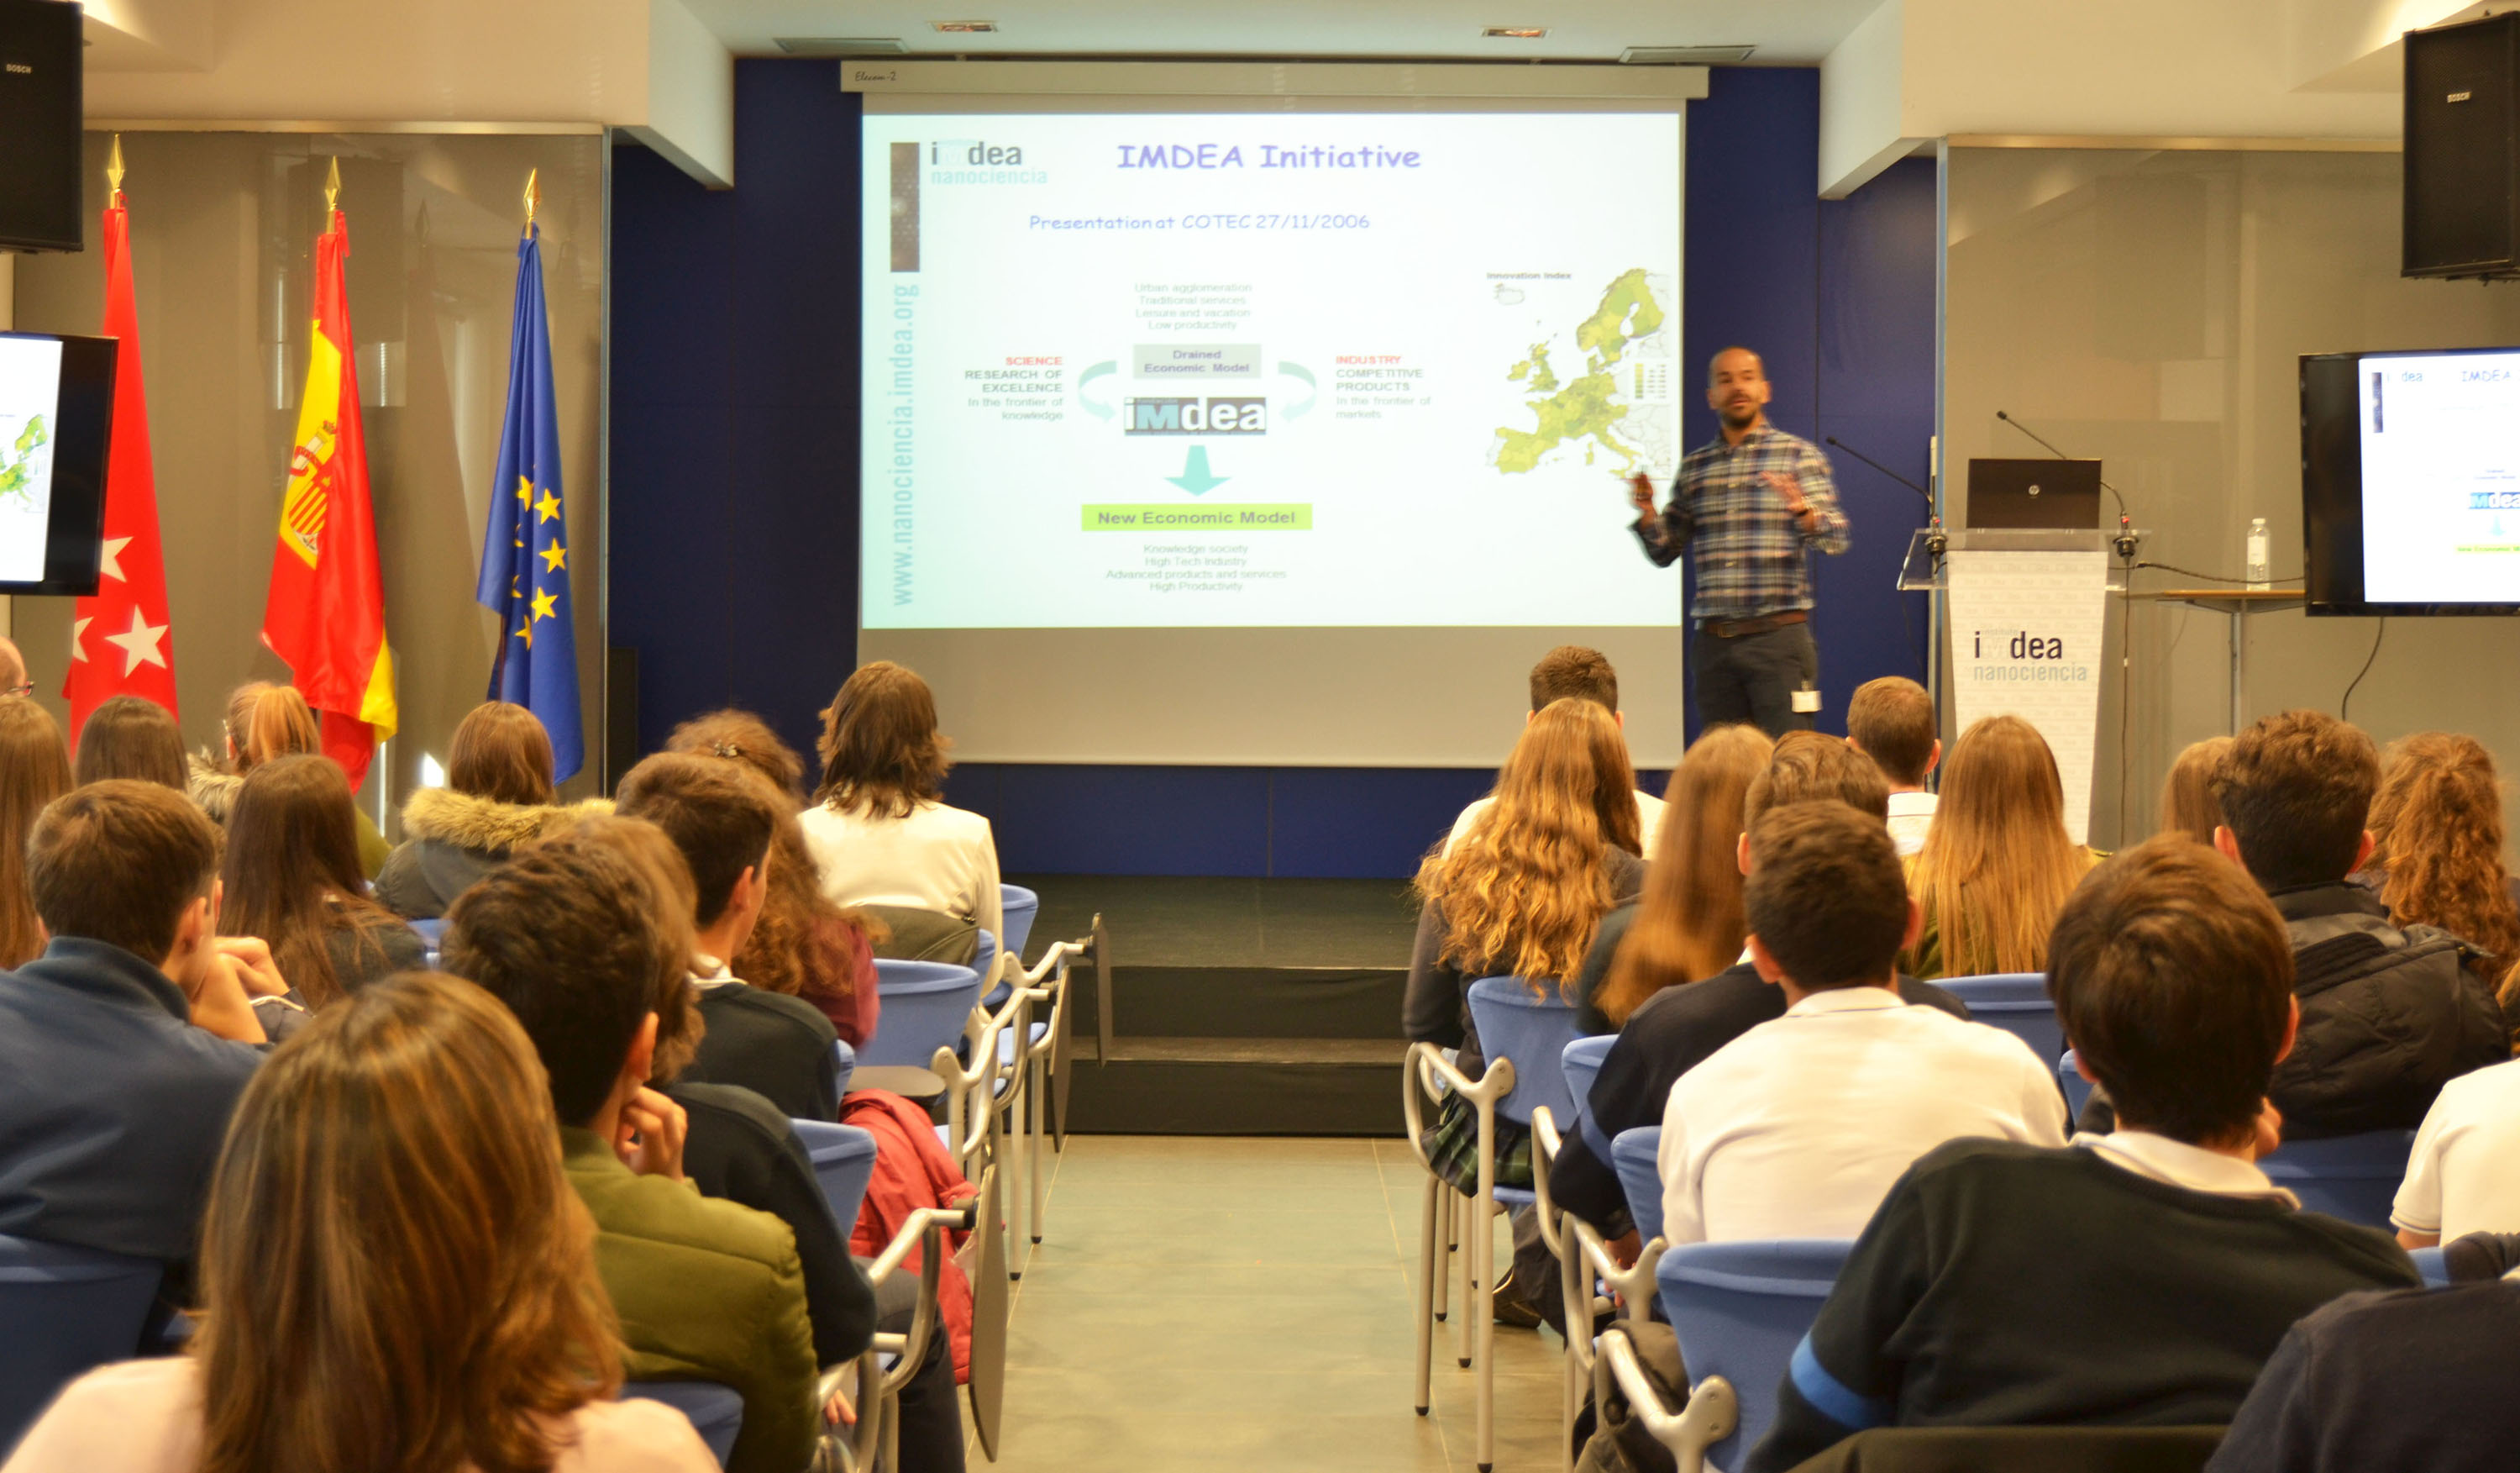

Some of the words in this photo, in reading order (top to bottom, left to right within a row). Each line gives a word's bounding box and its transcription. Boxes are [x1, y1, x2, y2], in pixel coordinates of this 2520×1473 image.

[7, 64, 31, 74] BOSCH
[1116, 143, 1243, 169] IMDEA
[1260, 145, 1420, 169] Initiative
[932, 168, 1047, 184] nanociencia
[1029, 215, 1152, 229] Presentation
[1155, 216, 1175, 229] at
[1181, 214, 1250, 229] COTEC
[1255, 214, 1370, 229] 27/11/2006
[1135, 283, 1168, 292] Urban
[1172, 283, 1252, 294] agglomeration
[1140, 296, 1197, 304] Traditional
[1200, 296, 1246, 304] services
[1136, 308, 1176, 317] Leisure
[1179, 308, 1200, 317] and
[1203, 308, 1251, 317] vacation
[1148, 320, 1170, 329] Low
[1174, 320, 1236, 331] productivity
[1173, 350, 1222, 360] Drained
[1336, 355, 1401, 365] INDUSTRY
[1005, 356, 1063, 366] SCIENCE
[1144, 364, 1205, 372] Economic
[1213, 363, 1250, 372] Model
[1336, 368, 1424, 377] COMPETITIVE
[965, 370, 1037, 379] RESEARCH
[1045, 370, 1063, 379] OF
[982, 383, 1063, 392] EXCELENCE
[1336, 381, 1410, 391] PRODUCTS
[968, 397, 979, 407] In
[983, 397, 1000, 407] the
[1005, 397, 1046, 407] frontier
[1052, 397, 1063, 407] of
[1336, 396, 1347, 405] In
[1351, 396, 1368, 405] the
[1373, 396, 1415, 405] frontier
[1420, 396, 1431, 405] of
[1002, 412, 1063, 421] knowledge
[1336, 409, 1382, 418] markets
[888, 285, 919, 606] www.nanociencia.imdea.org
[1098, 512, 1137, 524] New
[1142, 511, 1234, 523] Economic
[1240, 511, 1296, 523] Model
[1143, 544, 1205, 555] Knowledge
[1209, 544, 1248, 555] society
[1145, 557, 1170, 567] High
[1174, 557, 1200, 566] Tech
[1205, 556, 1247, 567] Industry
[1105, 570, 1162, 579] Advanced
[1165, 570, 1212, 581] products
[1216, 570, 1236, 579] and
[1240, 570, 1287, 579] services
[1150, 582, 1176, 592] High
[1179, 581, 1242, 592] Productivity
[1974, 661, 2088, 681] nanociencia
